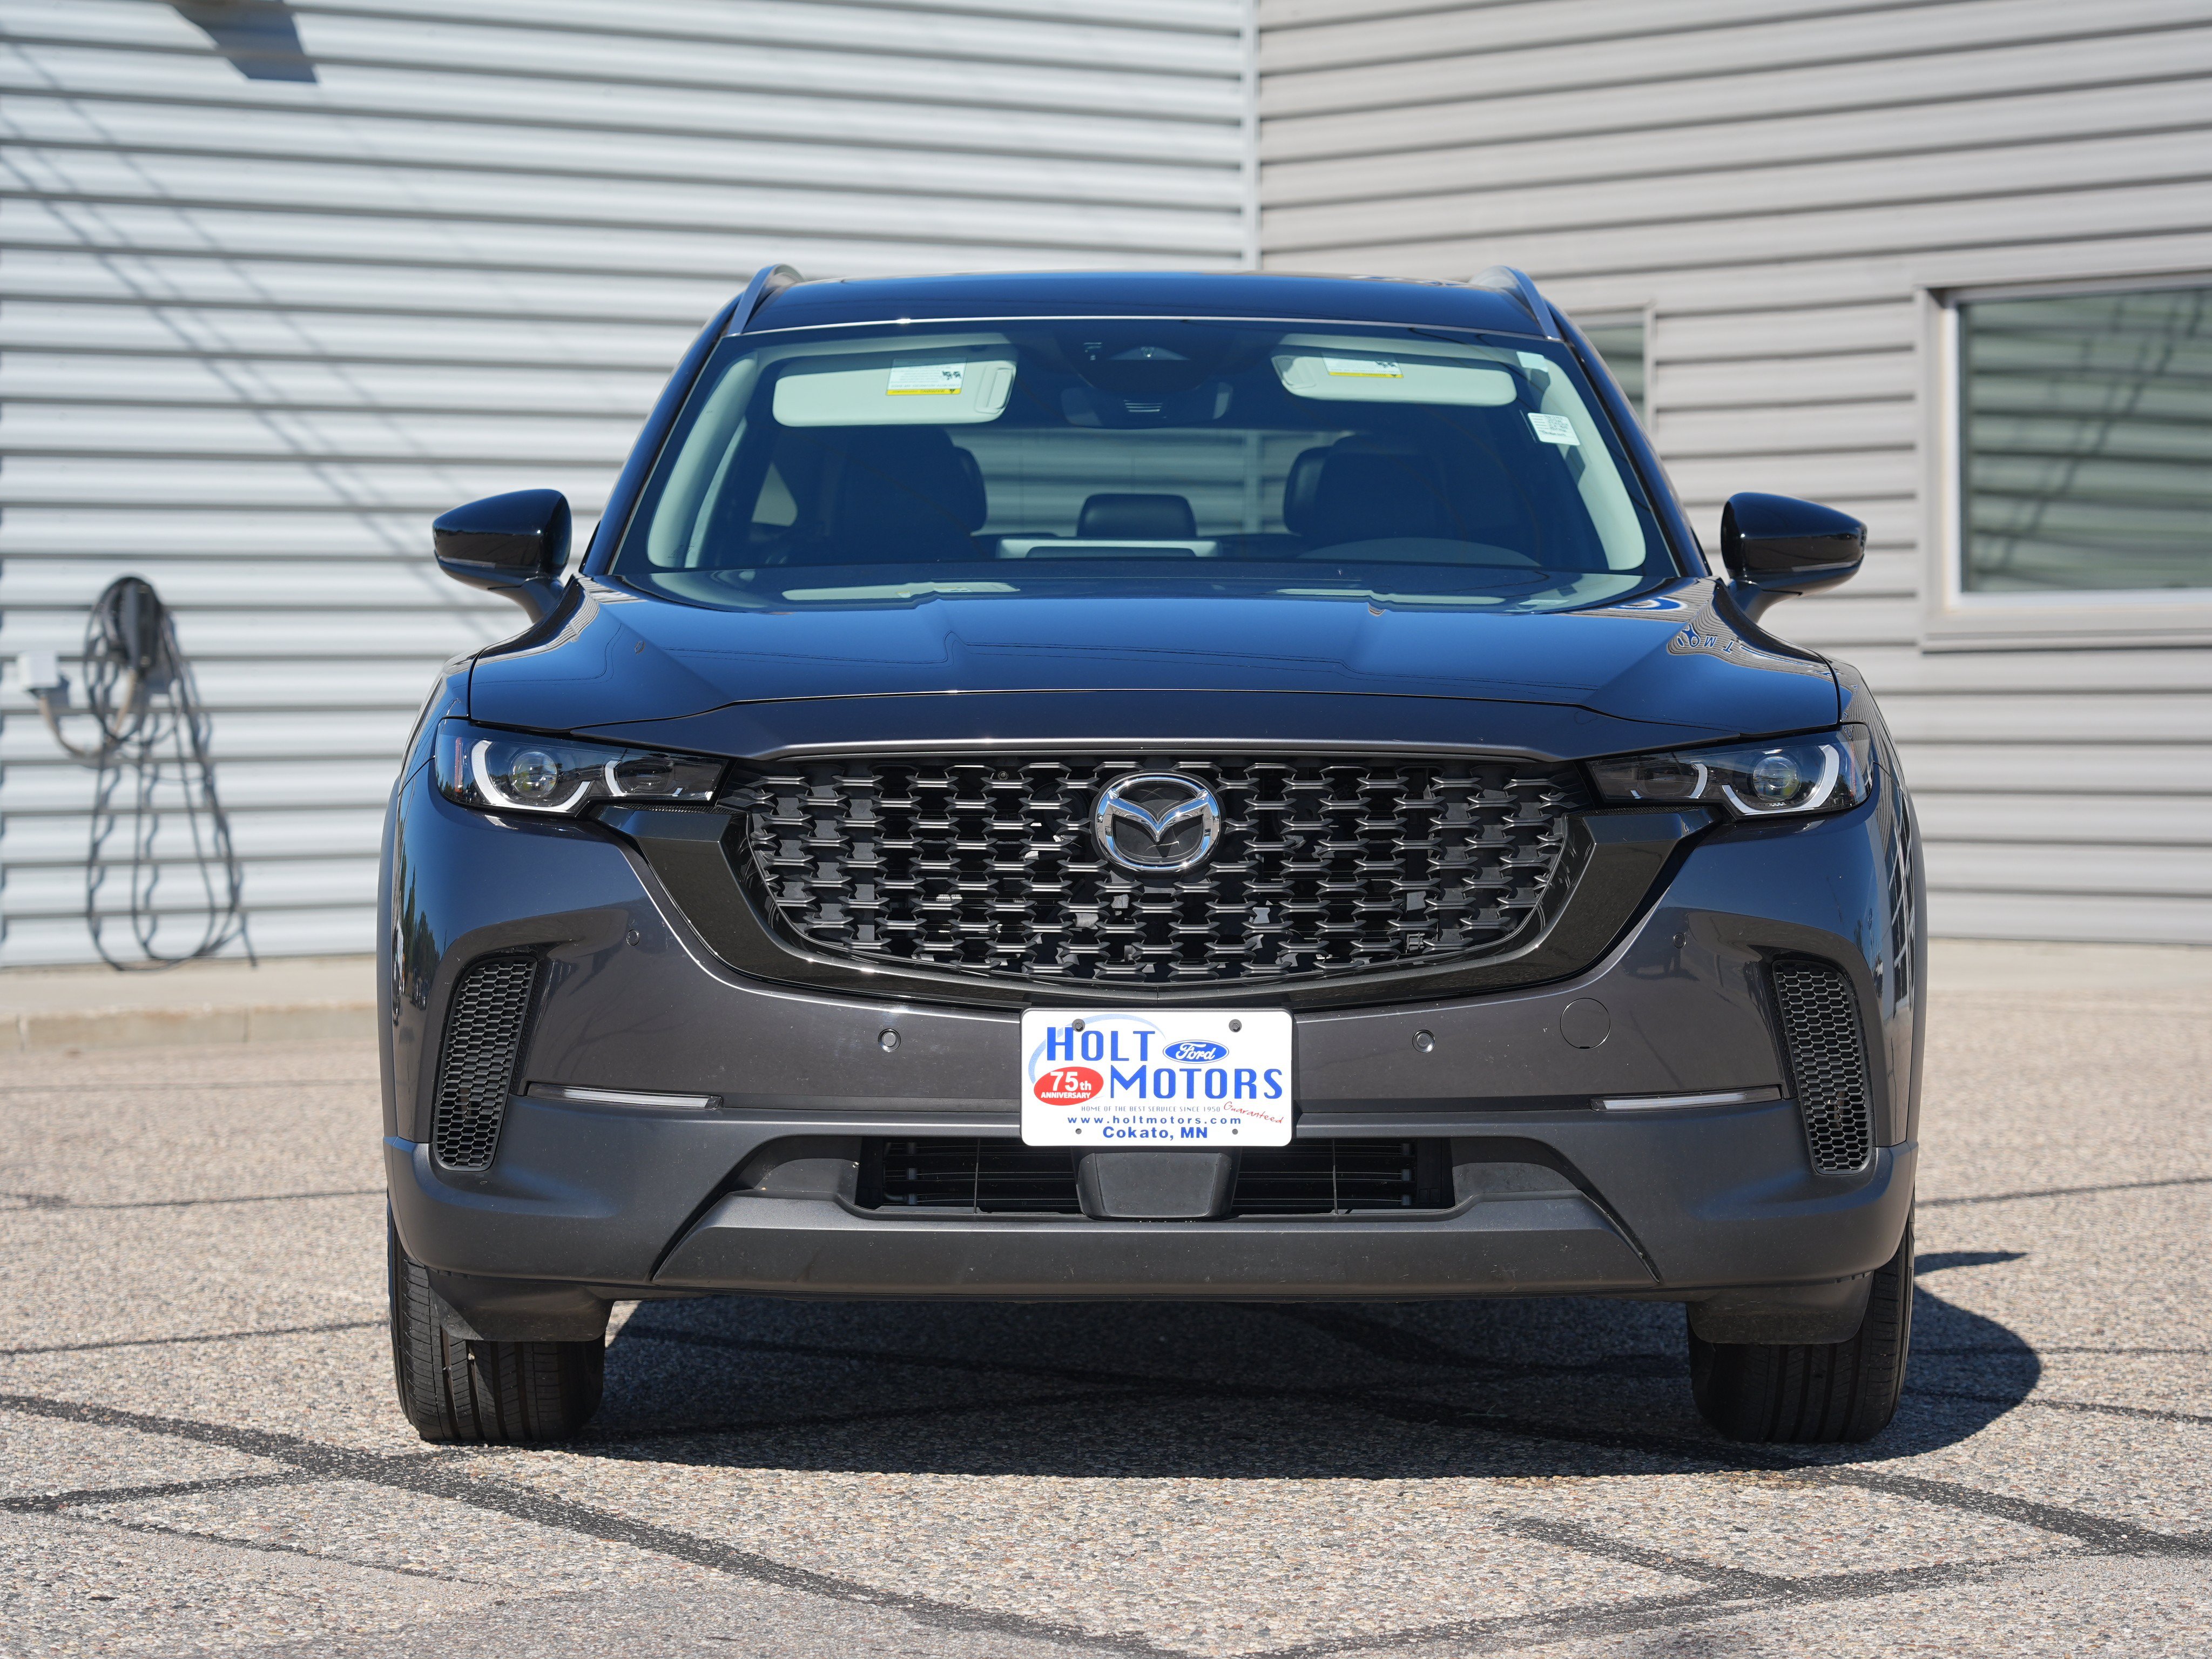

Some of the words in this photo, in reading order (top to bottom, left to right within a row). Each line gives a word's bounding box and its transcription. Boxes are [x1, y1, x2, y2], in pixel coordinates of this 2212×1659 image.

[1047, 1027, 1155, 1061] HOLT
[1175, 1042, 1217, 1060] Ford
[1050, 1071, 1092, 1091] 75th
[1110, 1064, 1283, 1099] MOTORS
[1067, 1115, 1241, 1124] www.holtmotors.com
[1223, 1101, 1284, 1124] Guaranteed
[1103, 1126, 1174, 1141] Cokato,
[1181, 1127, 1208, 1138] MN
